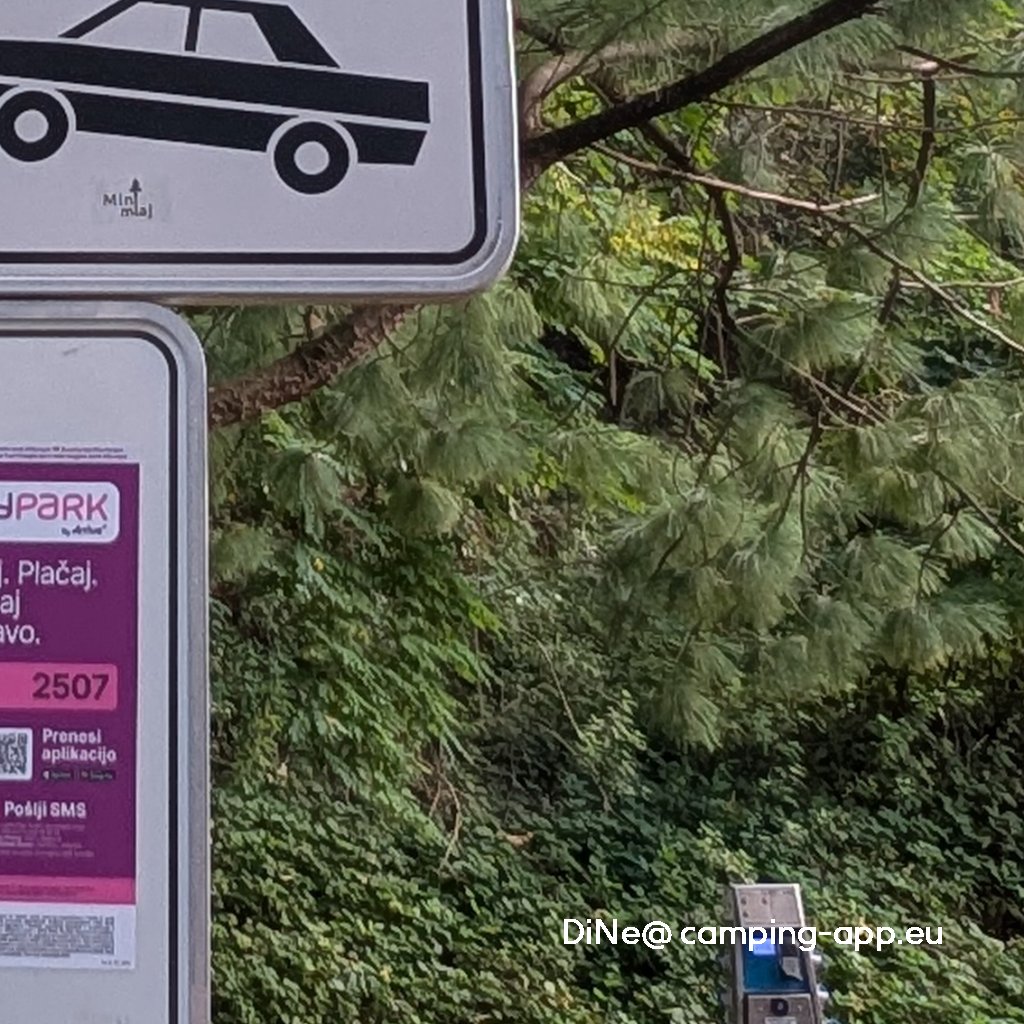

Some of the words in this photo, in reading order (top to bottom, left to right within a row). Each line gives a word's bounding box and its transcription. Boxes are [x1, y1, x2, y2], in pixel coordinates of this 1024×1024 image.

[32, 672, 109, 701] 2507
[42, 746, 117, 766] aplikacijo
[50, 802, 87, 818] SMS
